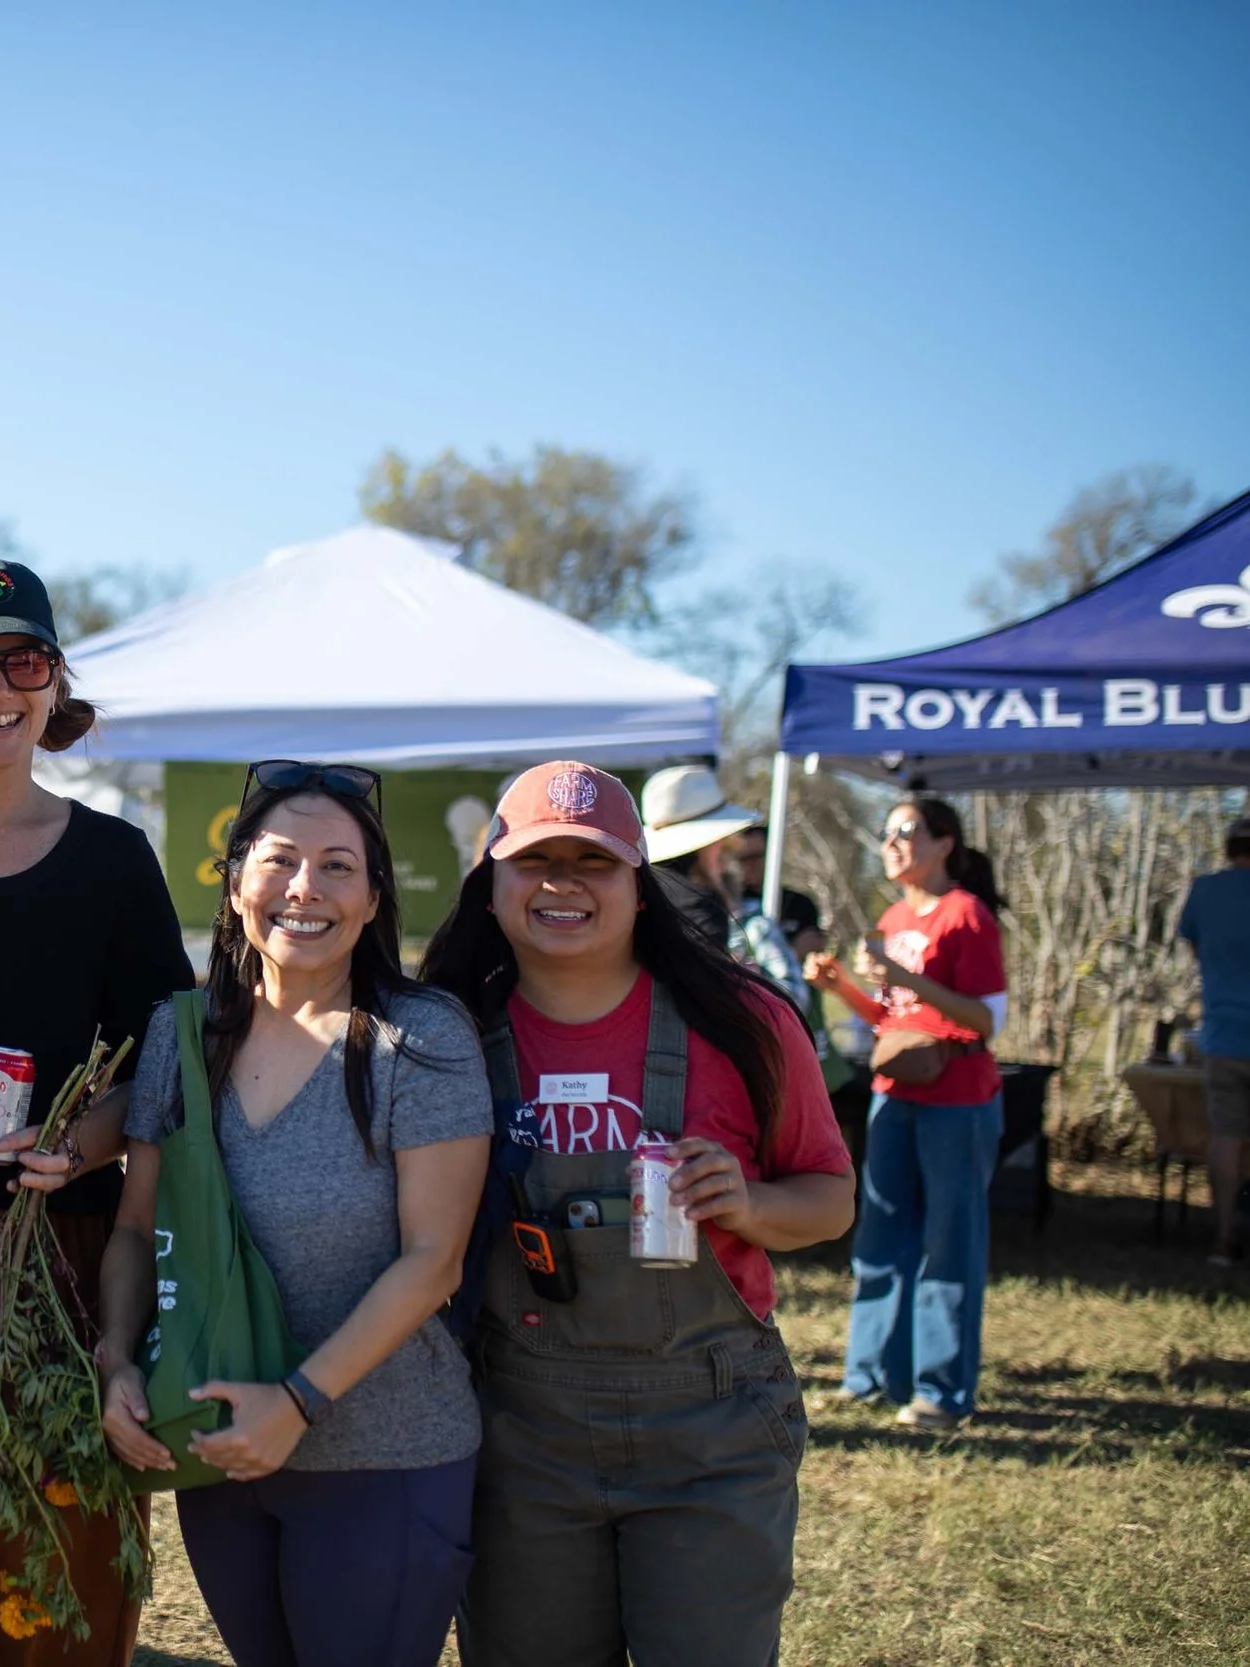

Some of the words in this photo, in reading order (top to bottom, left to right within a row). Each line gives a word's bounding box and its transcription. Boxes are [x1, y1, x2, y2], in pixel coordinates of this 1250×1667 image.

[853, 682, 1083, 731] ROYAL
[553, 774, 593, 791] FARM
[551, 788, 594, 807] SHARE
[562, 1081, 588, 1091] Kathy
[540, 1103, 666, 1155] ARM
